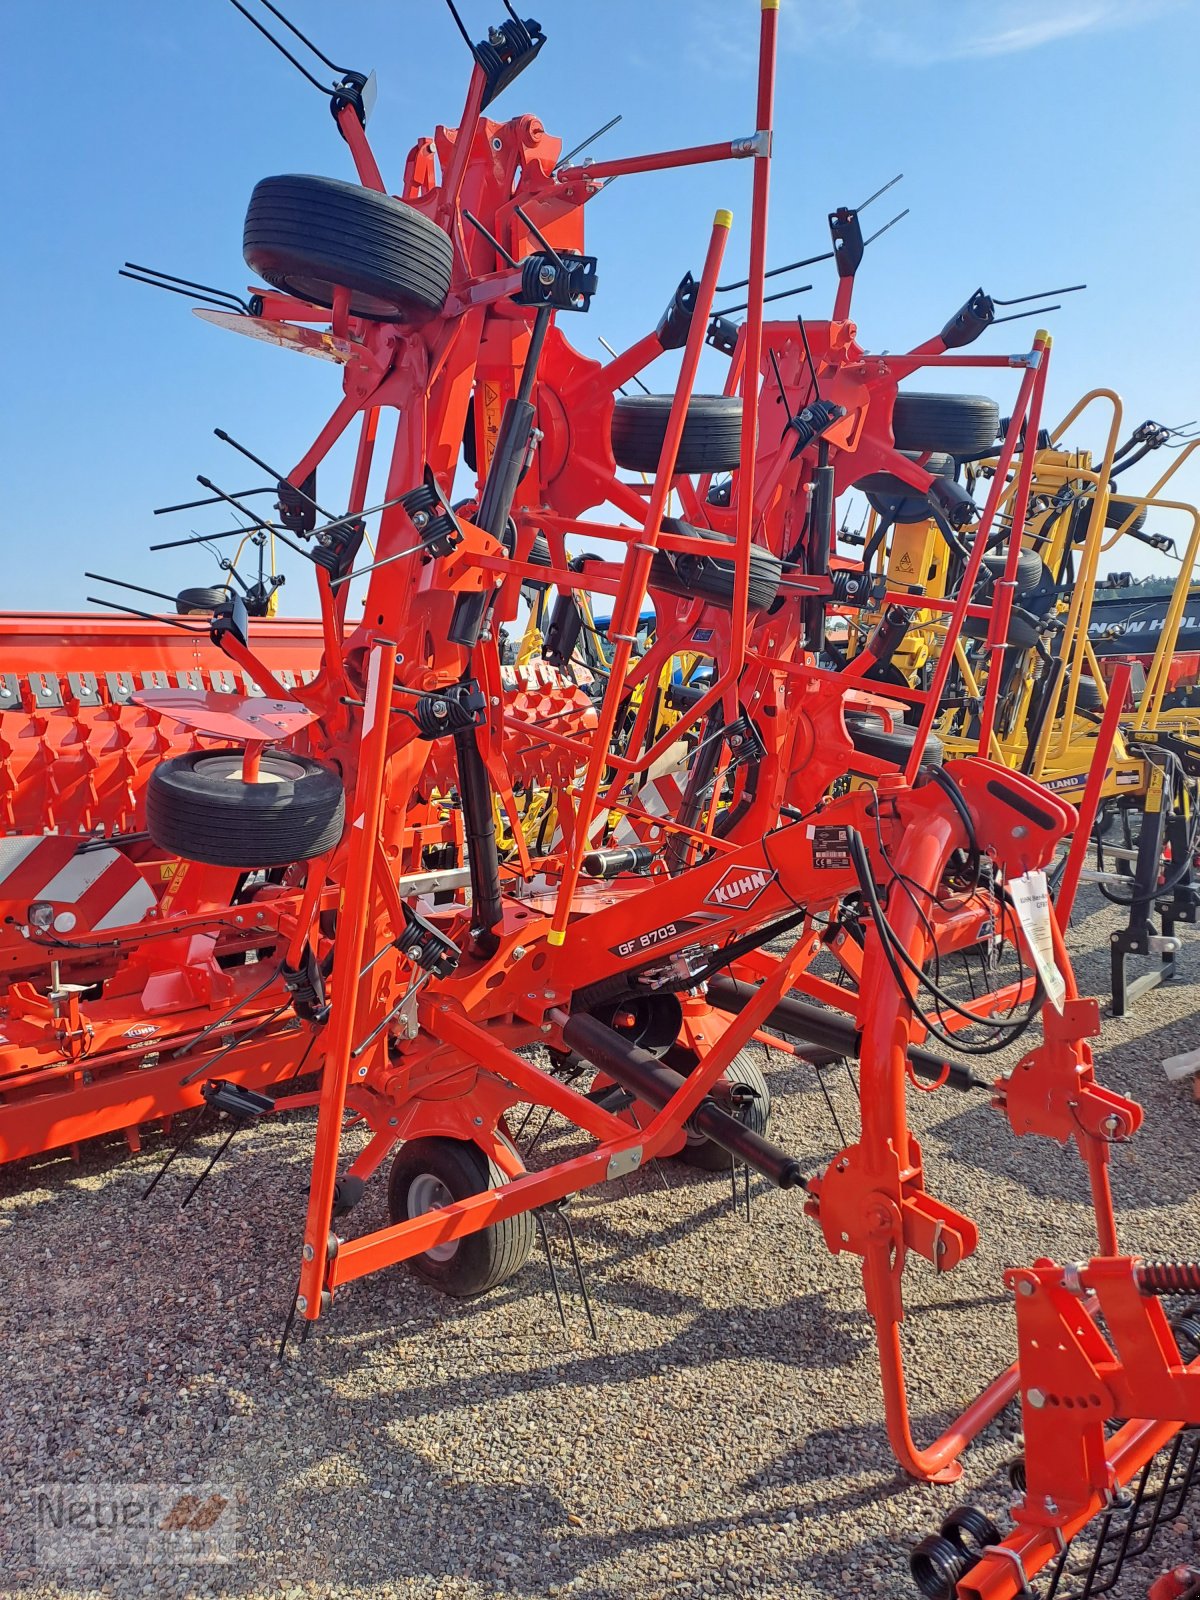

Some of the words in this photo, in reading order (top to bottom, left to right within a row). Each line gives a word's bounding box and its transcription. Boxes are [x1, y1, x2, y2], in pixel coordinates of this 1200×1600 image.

[714, 871, 766, 903] KUHN
[618, 940, 636, 956] GF
[640, 923, 677, 948] 8703
[127, 1026, 155, 1037] KUHN
